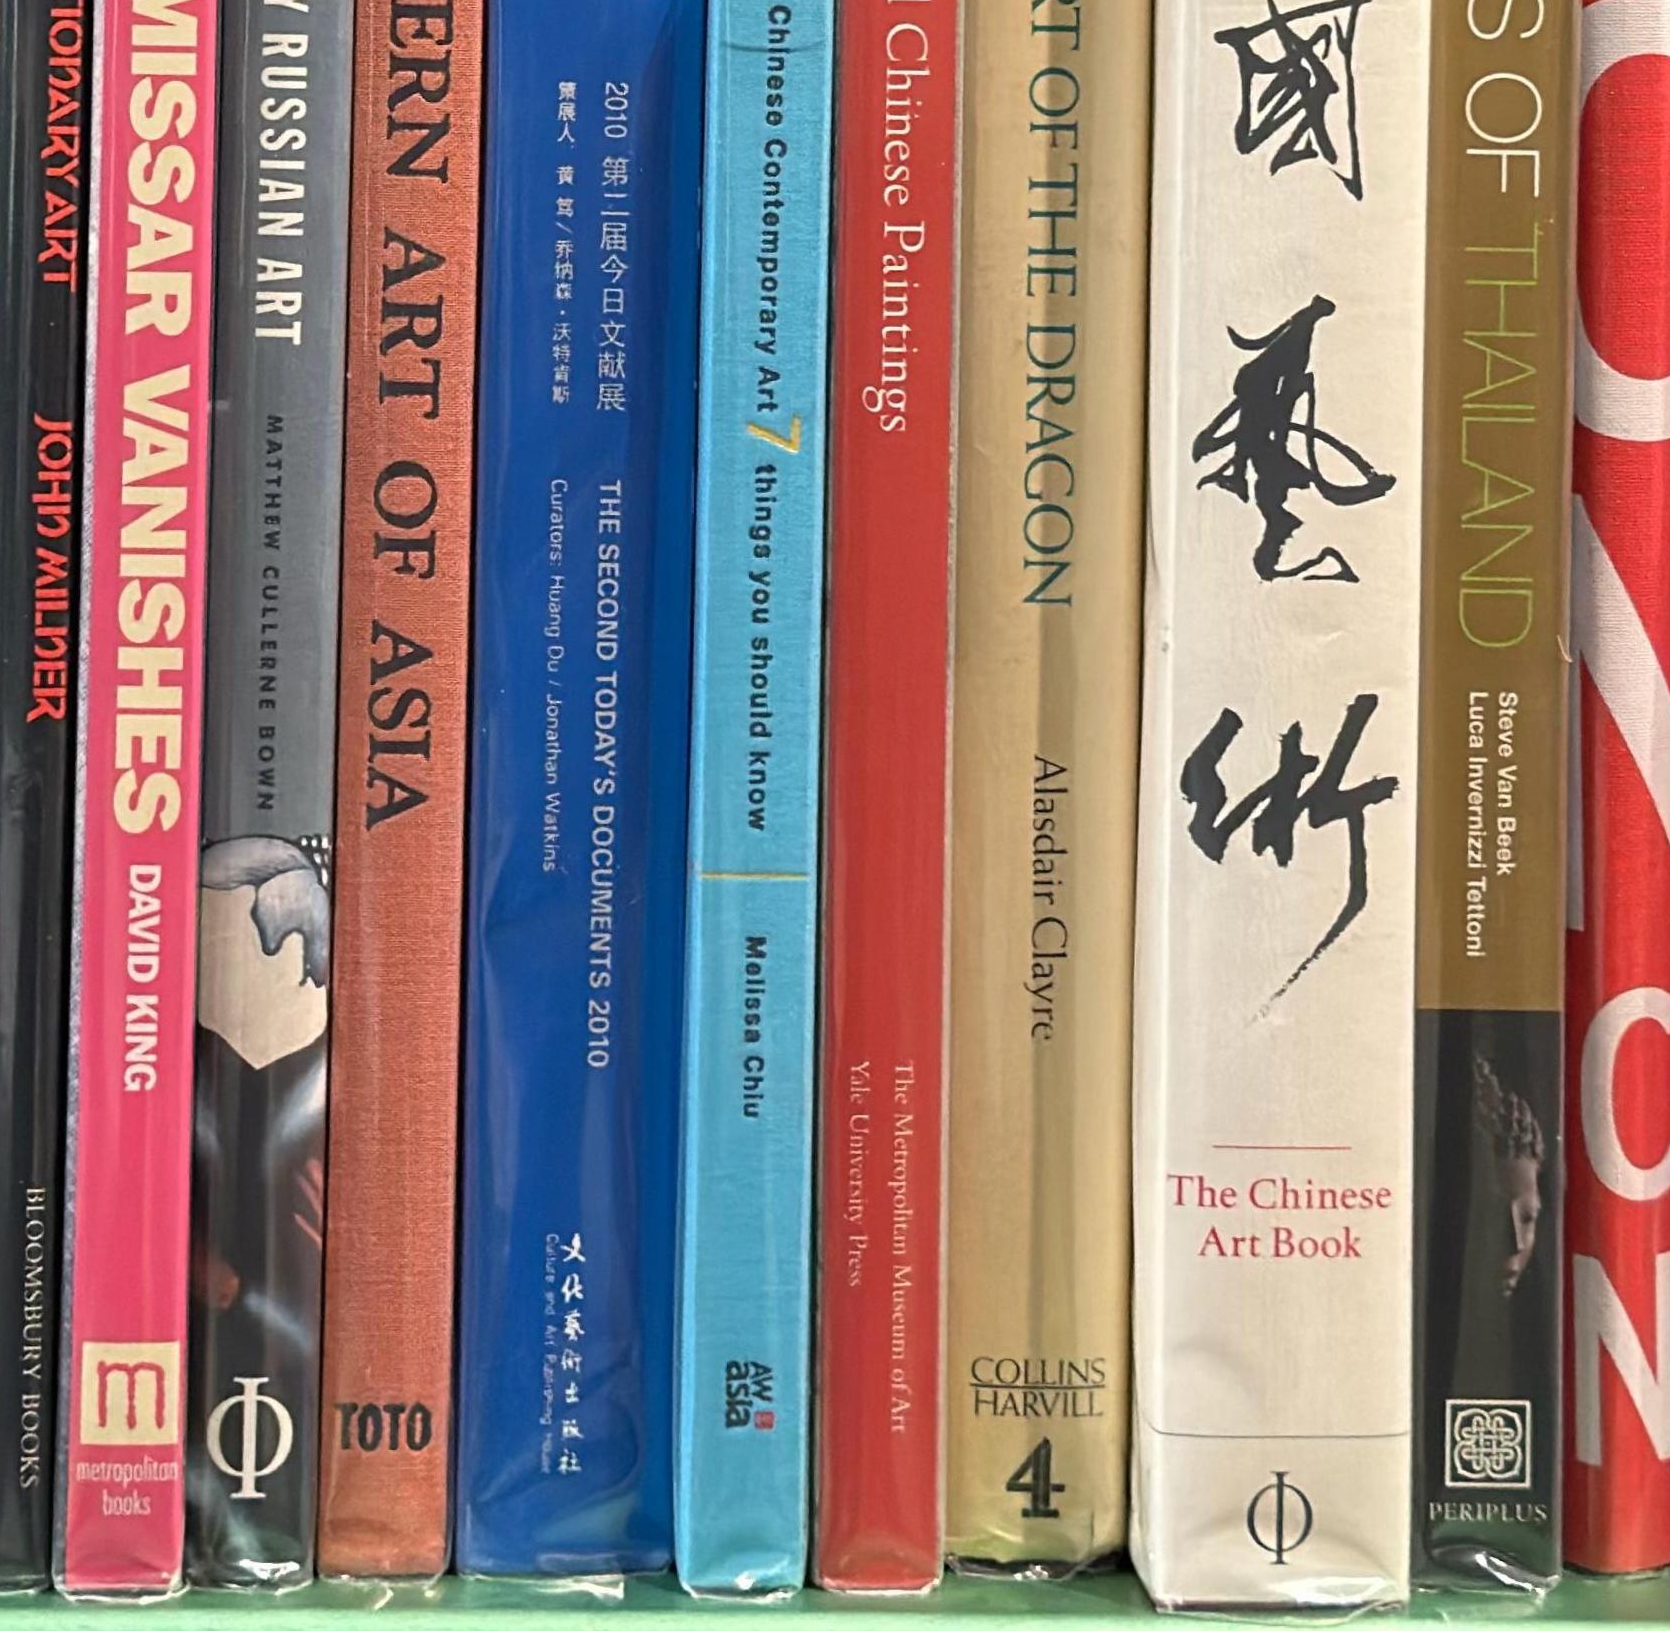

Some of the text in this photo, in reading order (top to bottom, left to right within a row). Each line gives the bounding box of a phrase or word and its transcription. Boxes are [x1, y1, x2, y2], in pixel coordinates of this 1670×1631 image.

[256, 31, 307, 239] RUSSIAN
[604, 82, 629, 139] 2010
[884, 21, 930, 206] Chinese
[1028, 66, 1081, 150] OF
[1464, 72, 1542, 199] OF
[252, 255, 303, 347] ART
[377, 226, 445, 421] ART
[1026, 162, 1078, 297] THE
[744, 4, 803, 833] Chinese Contemporary Art 7 things you should know
[861, 220, 926, 437] Paintings
[372, 460, 441, 581] OF
[1021, 323, 1080, 608] DRAGON
[1458, 220, 1538, 651] THAILAND
[110, 359, 192, 833] VANISHES
[365, 619, 433, 832] ASIA
[586, 479, 623, 1070] THE SECOND TODAY'S DOCUMENTS 2010
[1497, 692, 1518, 875] Steve Van Beek
[1030, 753, 1071, 1044] Alasdair Clayre
[1466, 692, 1489, 957] Luca Invernizzi Tettoni
[122, 865, 162, 1092] DAVID KING
[742, 936, 768, 1119] Melissa Chiu
[1167, 1174, 1392, 1211] The Chinese
[1197, 1224, 1363, 1259] Art Book
[333, 1401, 433, 1451] TOTO
